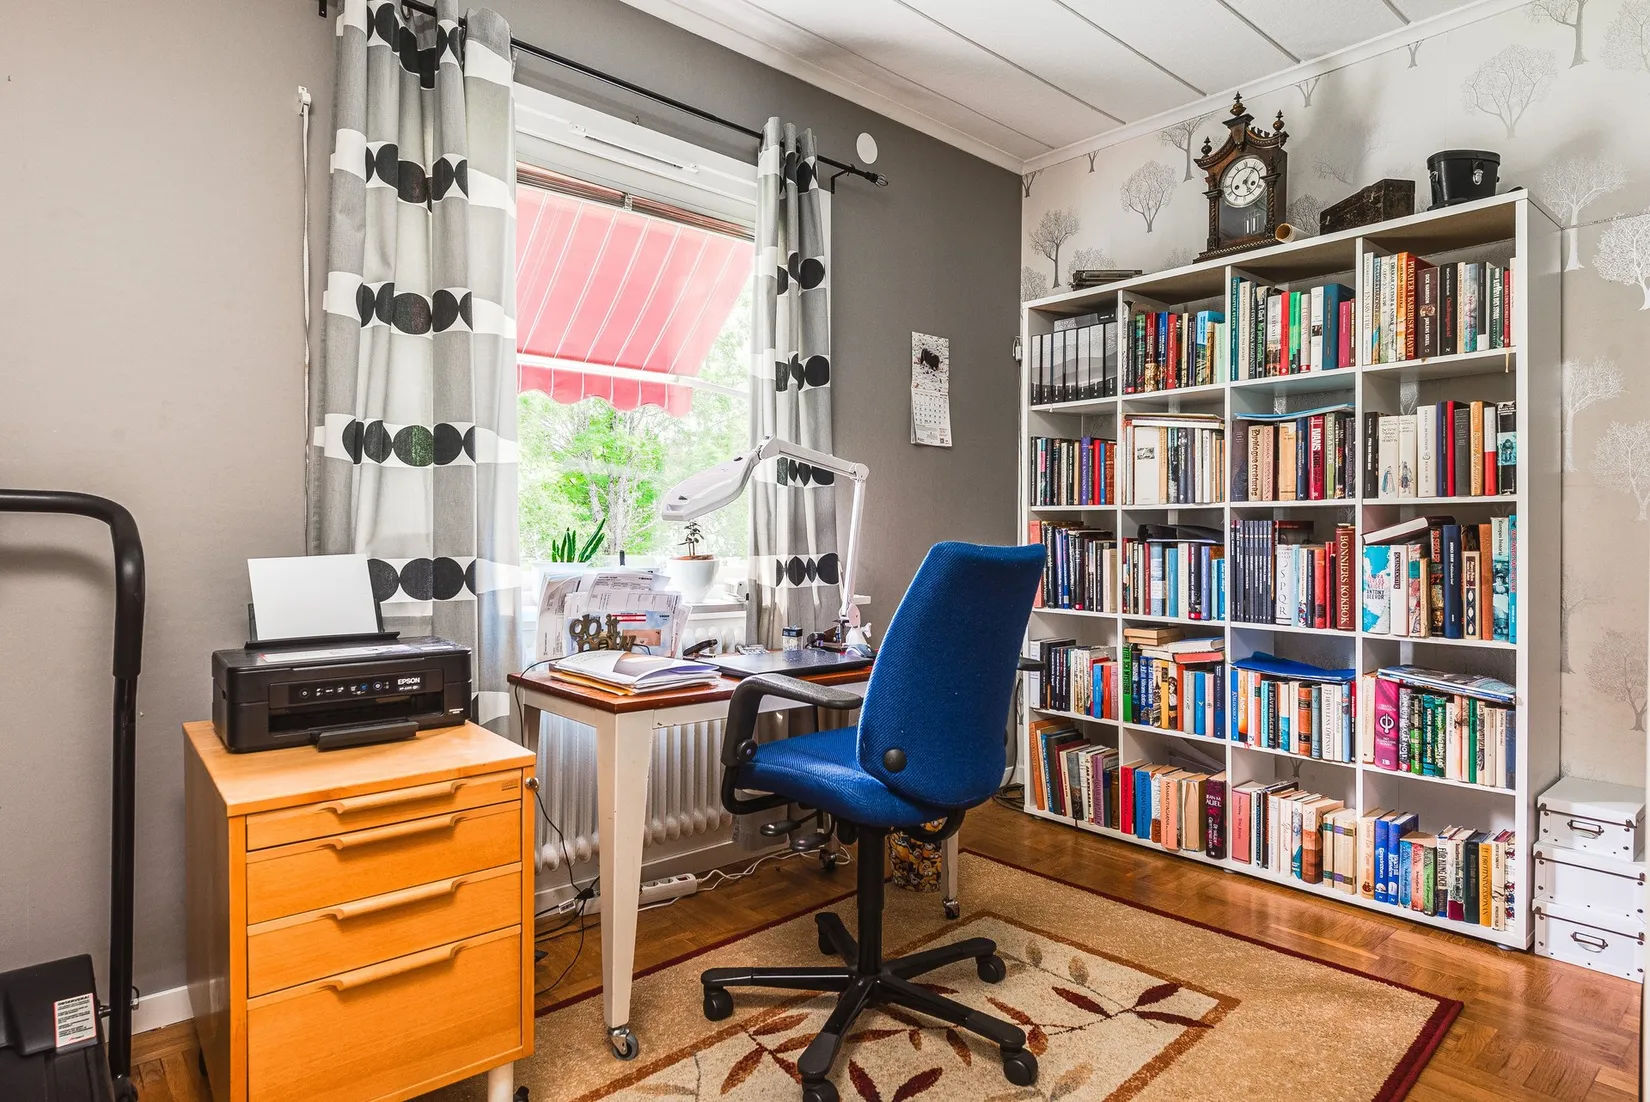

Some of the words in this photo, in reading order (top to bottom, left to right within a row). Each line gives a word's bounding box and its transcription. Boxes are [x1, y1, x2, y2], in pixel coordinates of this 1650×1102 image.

[1312, 428, 1321, 451] IVANS
[1495, 519, 1504, 537] Europas
[1340, 535, 1349, 583] BONNIERS
[1340, 586, 1349, 625] KOKBOK
[569, 614, 602, 637] do
[397, 677, 421, 685] EPSON
[1438, 847, 1447, 859] FÖR
[1438, 859, 1447, 875] KUNG
[1438, 875, 1447, 887] OCH
